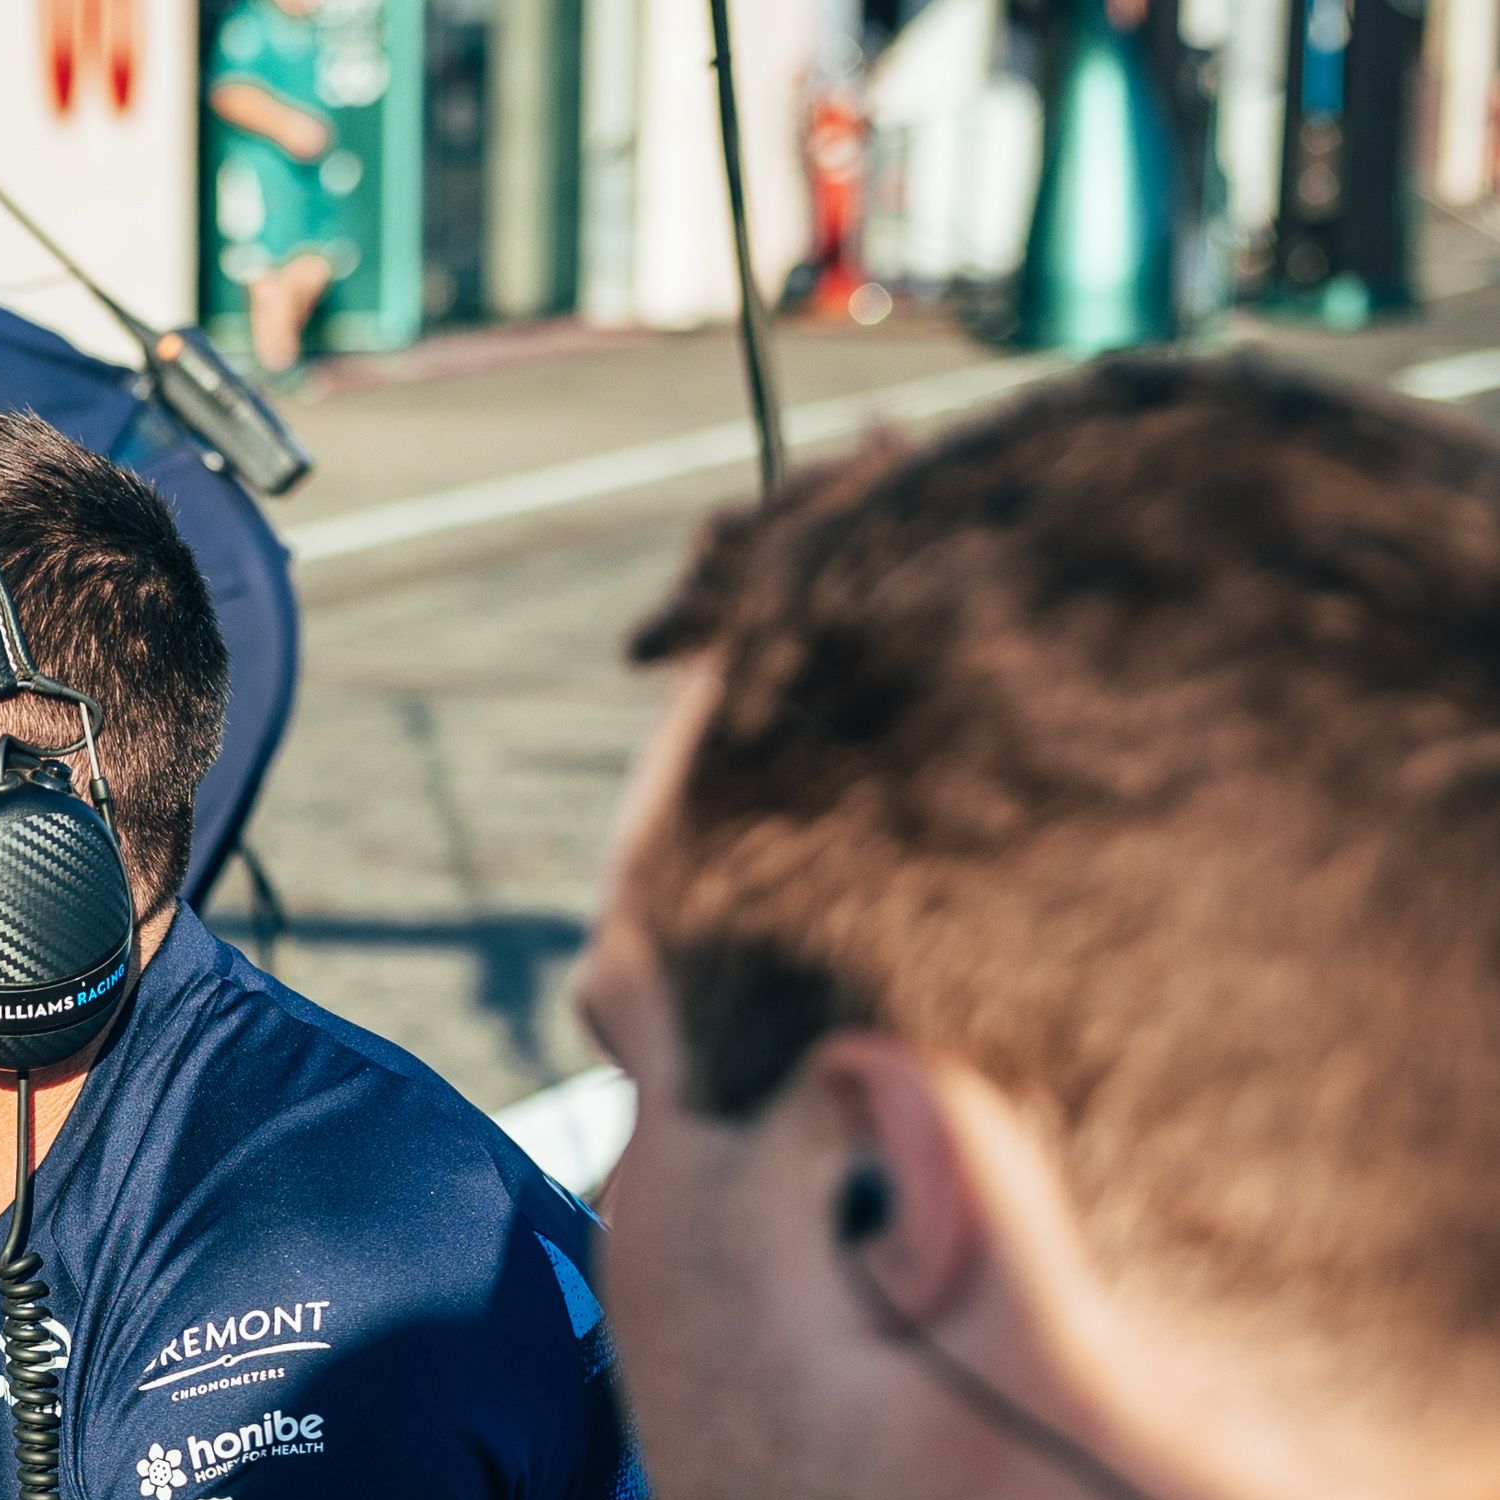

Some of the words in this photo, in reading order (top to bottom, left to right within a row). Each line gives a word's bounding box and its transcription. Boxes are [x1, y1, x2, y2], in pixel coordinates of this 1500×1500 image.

[77, 963, 125, 1006] RACING
[143, 1301, 330, 1374] REMONT
[171, 1367, 285, 1402] CHRONOMETERS
[186, 1409, 325, 1470] honibe
[241, 1448, 268, 1464] FOR
[271, 1442, 324, 1456] HEALTH
